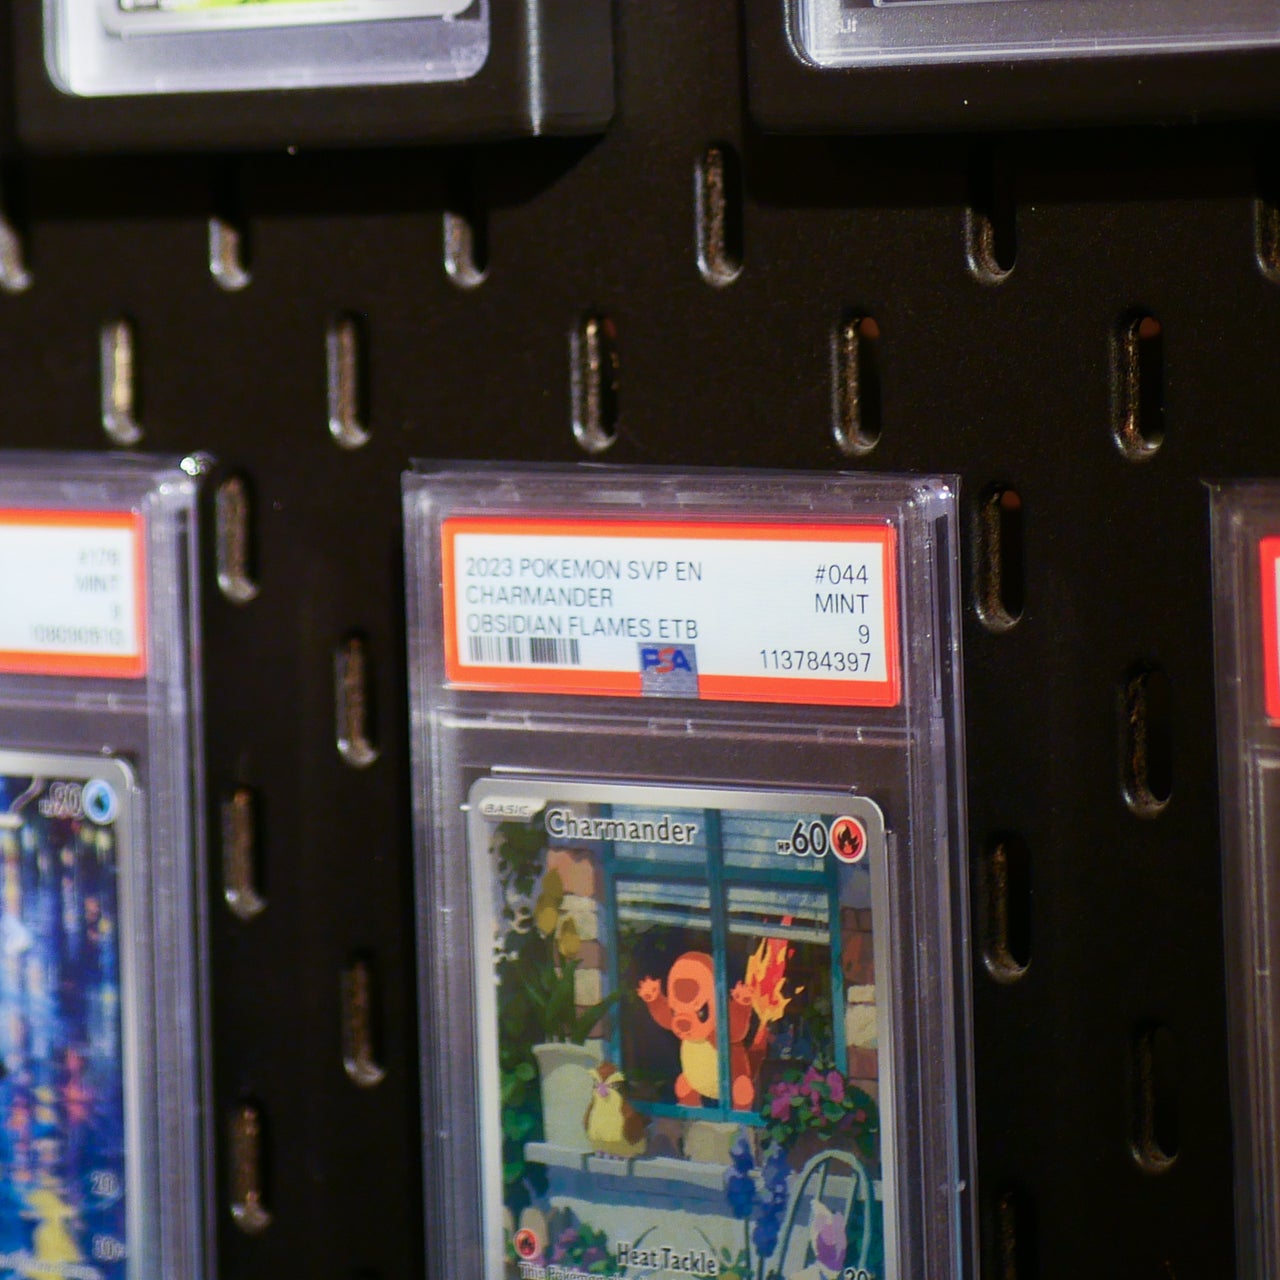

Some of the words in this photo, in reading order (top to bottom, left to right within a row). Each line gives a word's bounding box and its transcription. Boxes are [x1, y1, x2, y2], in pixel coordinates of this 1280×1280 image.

[466, 558, 513, 578] 2023
[519, 558, 621, 580] POKEMON
[627, 560, 667, 581] SVP
[676, 561, 702, 581] EN
[814, 564, 869, 585] #044
[466, 585, 613, 608] CHARMANDER
[814, 593, 869, 614] MINT
[467, 613, 562, 634] OBSIDIAN
[568, 616, 651, 638] FLAMES
[659, 619, 698, 640] ETB
[858, 625, 870, 645] 9
[641, 647, 692, 673] PSA
[759, 649, 872, 673] 113784397
[545, 808, 696, 844] Charmander
[791, 820, 827, 857] 60
[617, 1242, 657, 1266] Heat
[661, 1248, 717, 1276] Tackle
